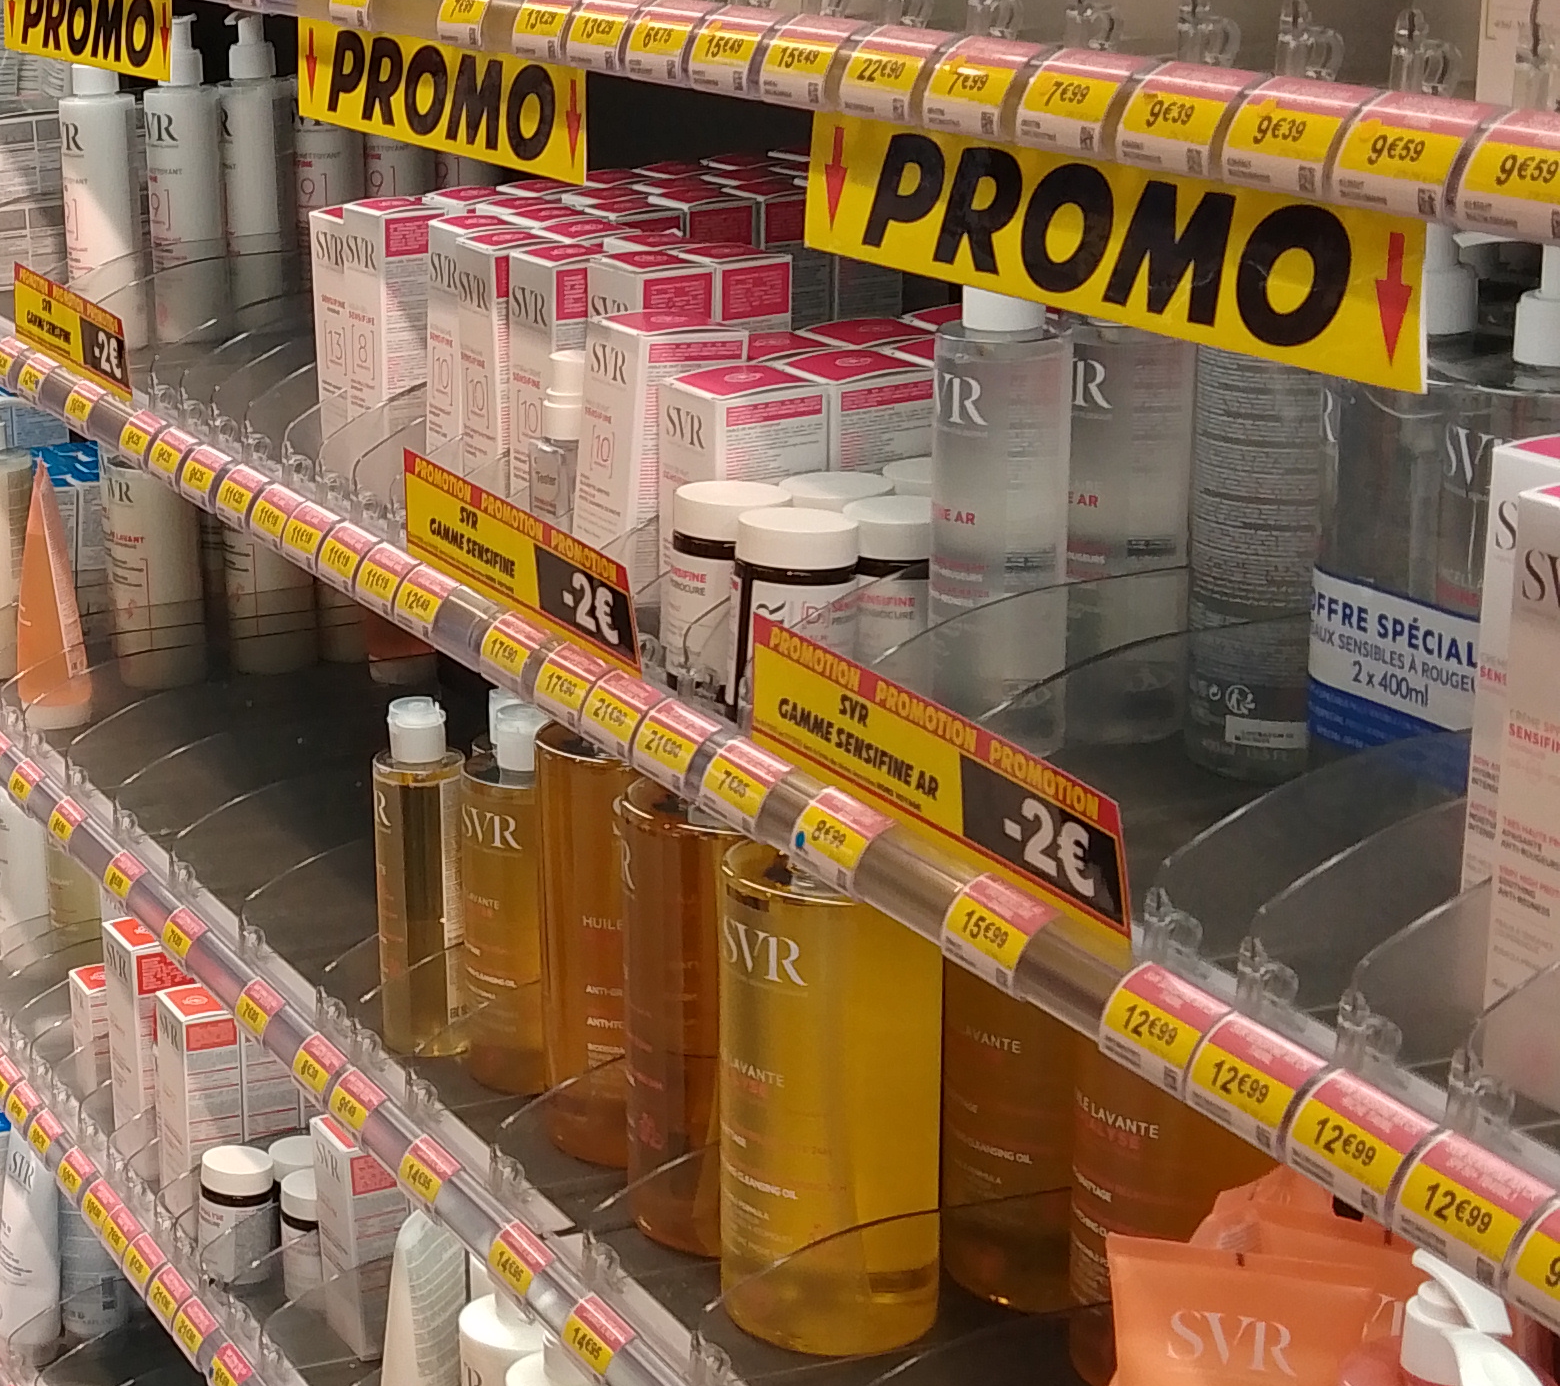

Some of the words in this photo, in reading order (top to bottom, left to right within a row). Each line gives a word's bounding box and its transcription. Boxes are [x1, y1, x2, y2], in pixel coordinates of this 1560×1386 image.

[526, 6, 558, 29] 13€29
[580, 16, 615, 39] 13€29
[642, 26, 672, 47] 6€75
[704, 34, 743, 58] 15€49
[777, 46, 820, 70] 15€49
[856, 57, 905, 82] 22€90
[948, 70, 990, 95] 7€99
[328, 29, 556, 162] PROMO
[1044, 80, 1091, 107] 7€99
[1146, 97, 1194, 127] 9€39
[144, 112, 179, 144] VR
[1252, 113, 1306, 143] 9€39
[1368, 134, 1426, 165] 9€59
[1495, 154, 1557, 186] 9€59
[345, 233, 377, 271] SVR
[861, 132, 1352, 346] PROMO
[430, 252, 458, 291] SVR
[458, 270, 490, 312] SVR
[512, 284, 547, 327] SVR
[93, 329, 123, 380] -2€
[590, 342, 627, 385] SVR
[666, 403, 704, 450] SVR
[459, 505, 479, 532] SVR
[953, 510, 976, 525] AR
[1076, 493, 1098, 507] AR
[414, 458, 472, 505] PROMOTION
[480, 491, 544, 542] PROMOTION
[550, 529, 618, 584] PROMOTION
[429, 517, 465, 554] GAMME
[465, 538, 516, 579] SENSIFINE
[561, 571, 620, 645] -2€
[1311, 624, 1335, 646] AUX
[1338, 633, 1405, 671] SENSIBLES
[1408, 652, 1418, 672] À
[1378, 615, 1477, 668] SPÉCIAL
[1352, 661, 1363, 683] 2
[1366, 671, 1376, 687] x
[1378, 672, 1429, 708] 400ml
[769, 625, 861, 692] PROMOTION
[875, 681, 977, 753] PROMOTION
[988, 743, 1100, 820] PROMOTION
[838, 693, 869, 728] SVR
[778, 697, 834, 743] GAMME
[834, 728, 913, 788] SENSIFINE
[913, 769, 939, 801] AR
[462, 803, 522, 850] SVR
[1001, 798, 1098, 898] -2€
[961, 909, 1009, 949] 15€99
[723, 915, 808, 987] SVR
[159, 1011, 181, 1051] SVR
[965, 1025, 1021, 1054] AVANTE
[1121, 1002, 1178, 1047] 12€99
[1210, 1059, 1270, 1105] 12€99
[1091, 1101, 1160, 1140] LAVANTE
[1313, 1116, 1377, 1167] 12€99
[9, 1150, 35, 1190] SVR
[1424, 1181, 1493, 1234] 12€99
[496, 1250, 522, 1282] 14€95
[571, 1326, 602, 1361] 14€95
[1166, 1309, 1298, 1377] SVR
